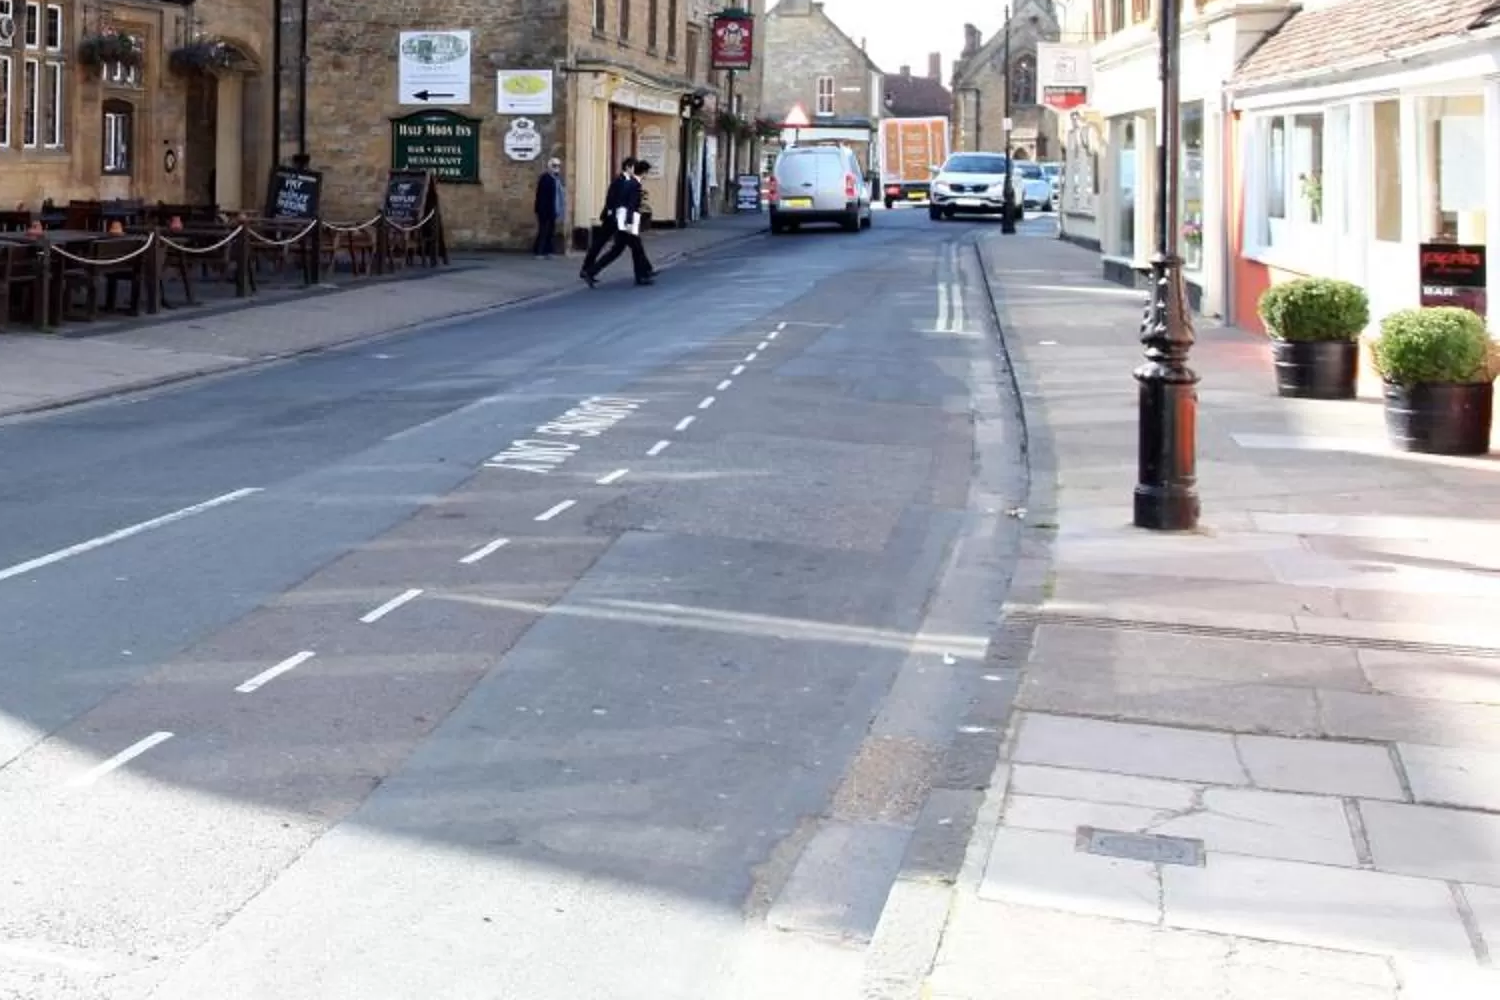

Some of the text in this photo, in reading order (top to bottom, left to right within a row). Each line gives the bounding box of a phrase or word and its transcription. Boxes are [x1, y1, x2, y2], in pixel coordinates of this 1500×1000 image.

[400, 124, 471, 137] HALF MOON INN
